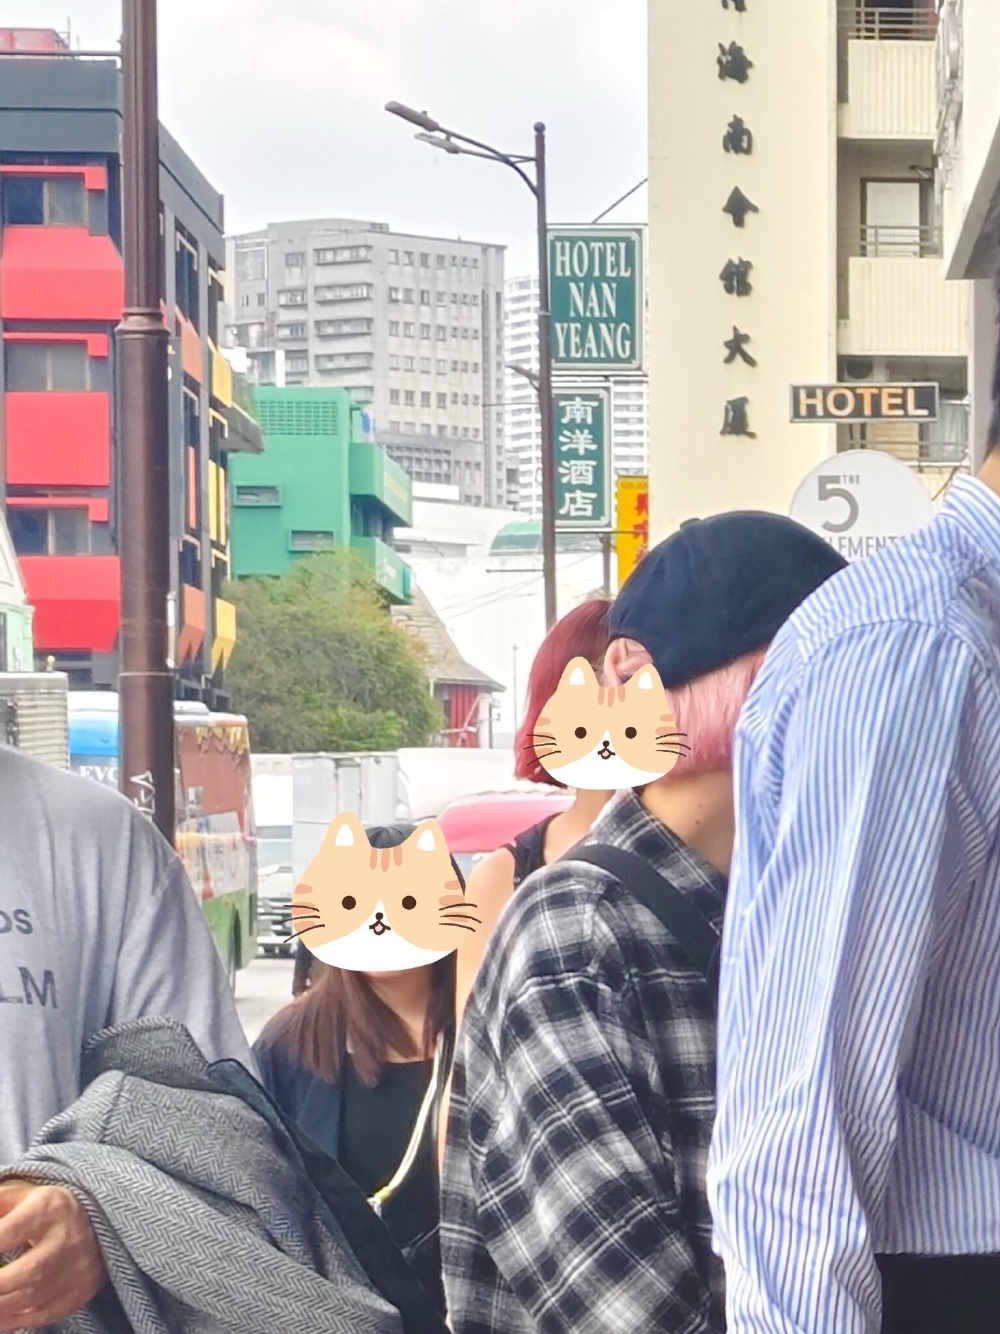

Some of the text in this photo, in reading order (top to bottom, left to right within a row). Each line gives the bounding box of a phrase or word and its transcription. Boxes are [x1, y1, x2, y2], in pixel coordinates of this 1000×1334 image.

[554, 240, 632, 278] HOTEL
[568, 281, 618, 319] NAN
[554, 321, 632, 360] YEANG
[799, 386, 930, 418] HOTEL
[557, 396, 600, 518] 南洋酒店
[817, 474, 860, 534] 5
[823, 535, 905, 559] EMENT
